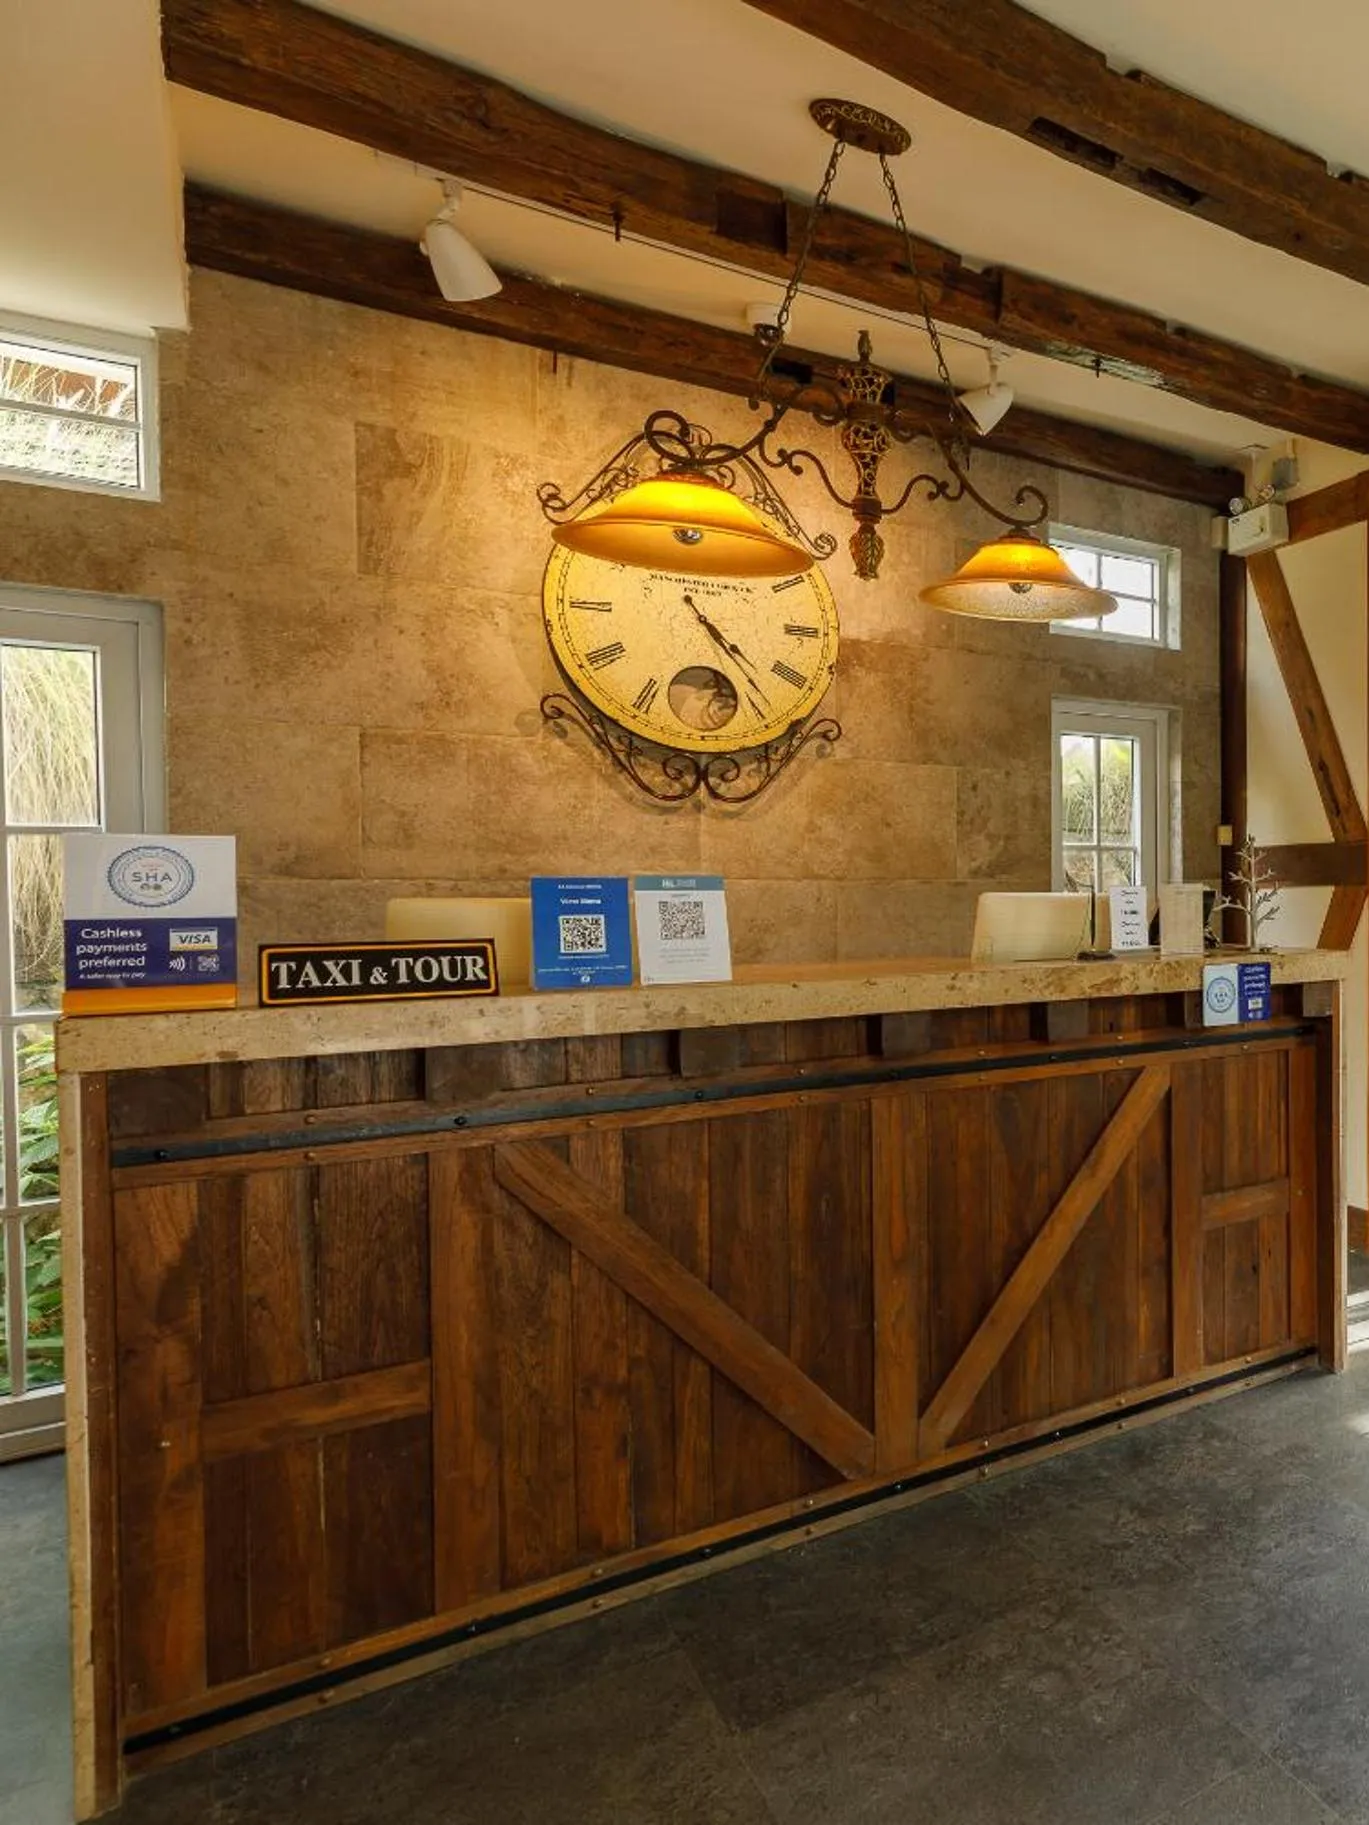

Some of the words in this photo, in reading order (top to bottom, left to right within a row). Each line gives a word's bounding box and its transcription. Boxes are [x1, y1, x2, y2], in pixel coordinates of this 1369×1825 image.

[132, 871, 173, 882] SHA
[81, 927, 142, 939] Cashless
[178, 934, 212, 944] VISA
[76, 942, 147, 955] payments
[78, 956, 145, 970] preferred
[131, 971, 147, 980] pay
[271, 959, 363, 989] TAXI
[369, 966, 388, 985] &
[391, 955, 488, 985] TOUR
